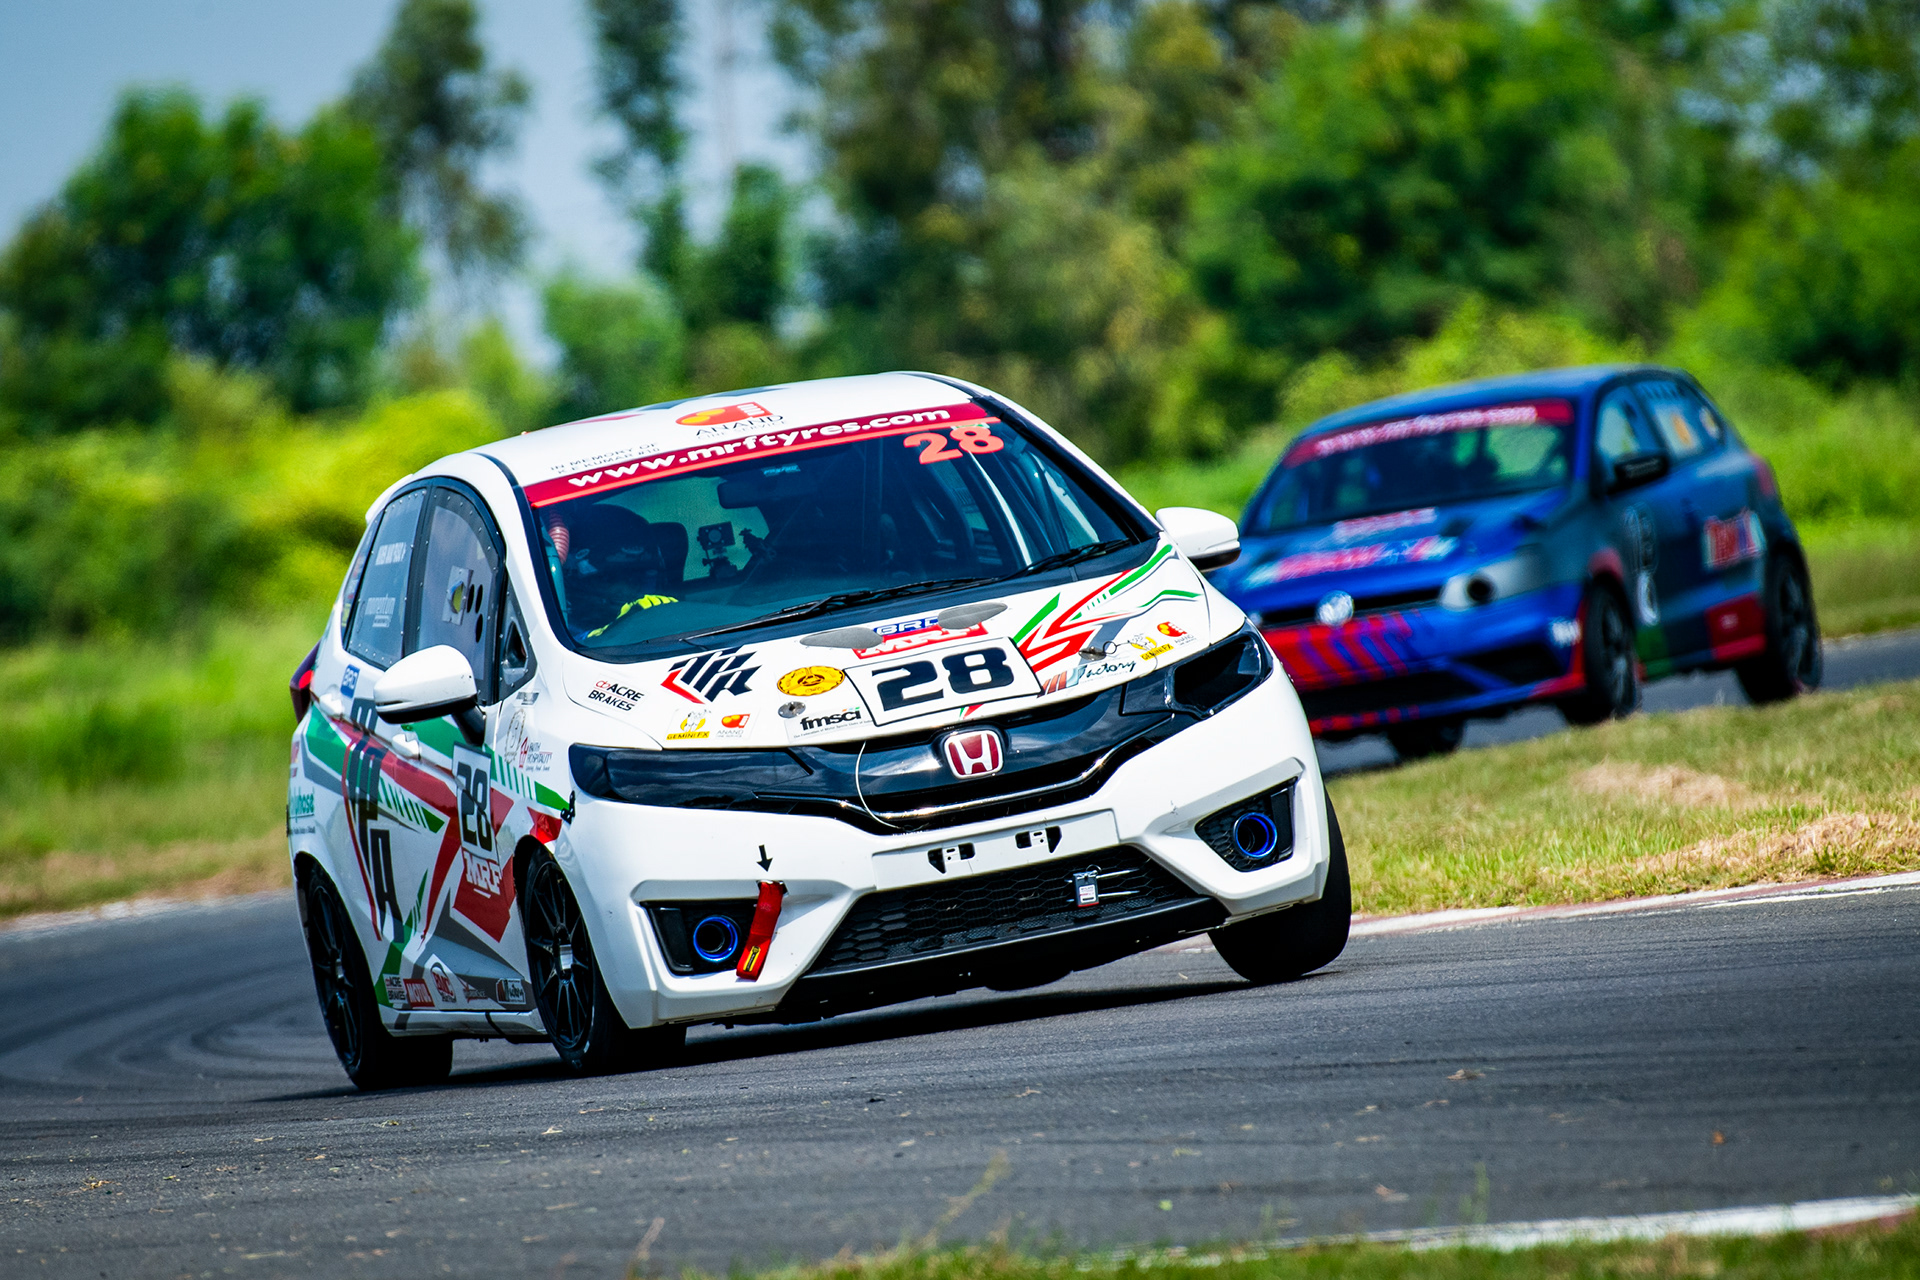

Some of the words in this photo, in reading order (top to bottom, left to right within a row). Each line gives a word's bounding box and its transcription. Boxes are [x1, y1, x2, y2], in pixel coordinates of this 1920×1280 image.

[696, 414, 784, 436] ANAND
[568, 409, 950, 487] www.mrftyres.com
[569, 447, 633, 466] MEMORY
[903, 427, 1004, 464] 28
[606, 682, 644, 701] ACRE
[871, 647, 1015, 712] 28
[587, 689, 635, 711] BRAKES
[800, 709, 862, 731] fmsci
[456, 761, 492, 852] 28
[462, 850, 502, 895] MRF
